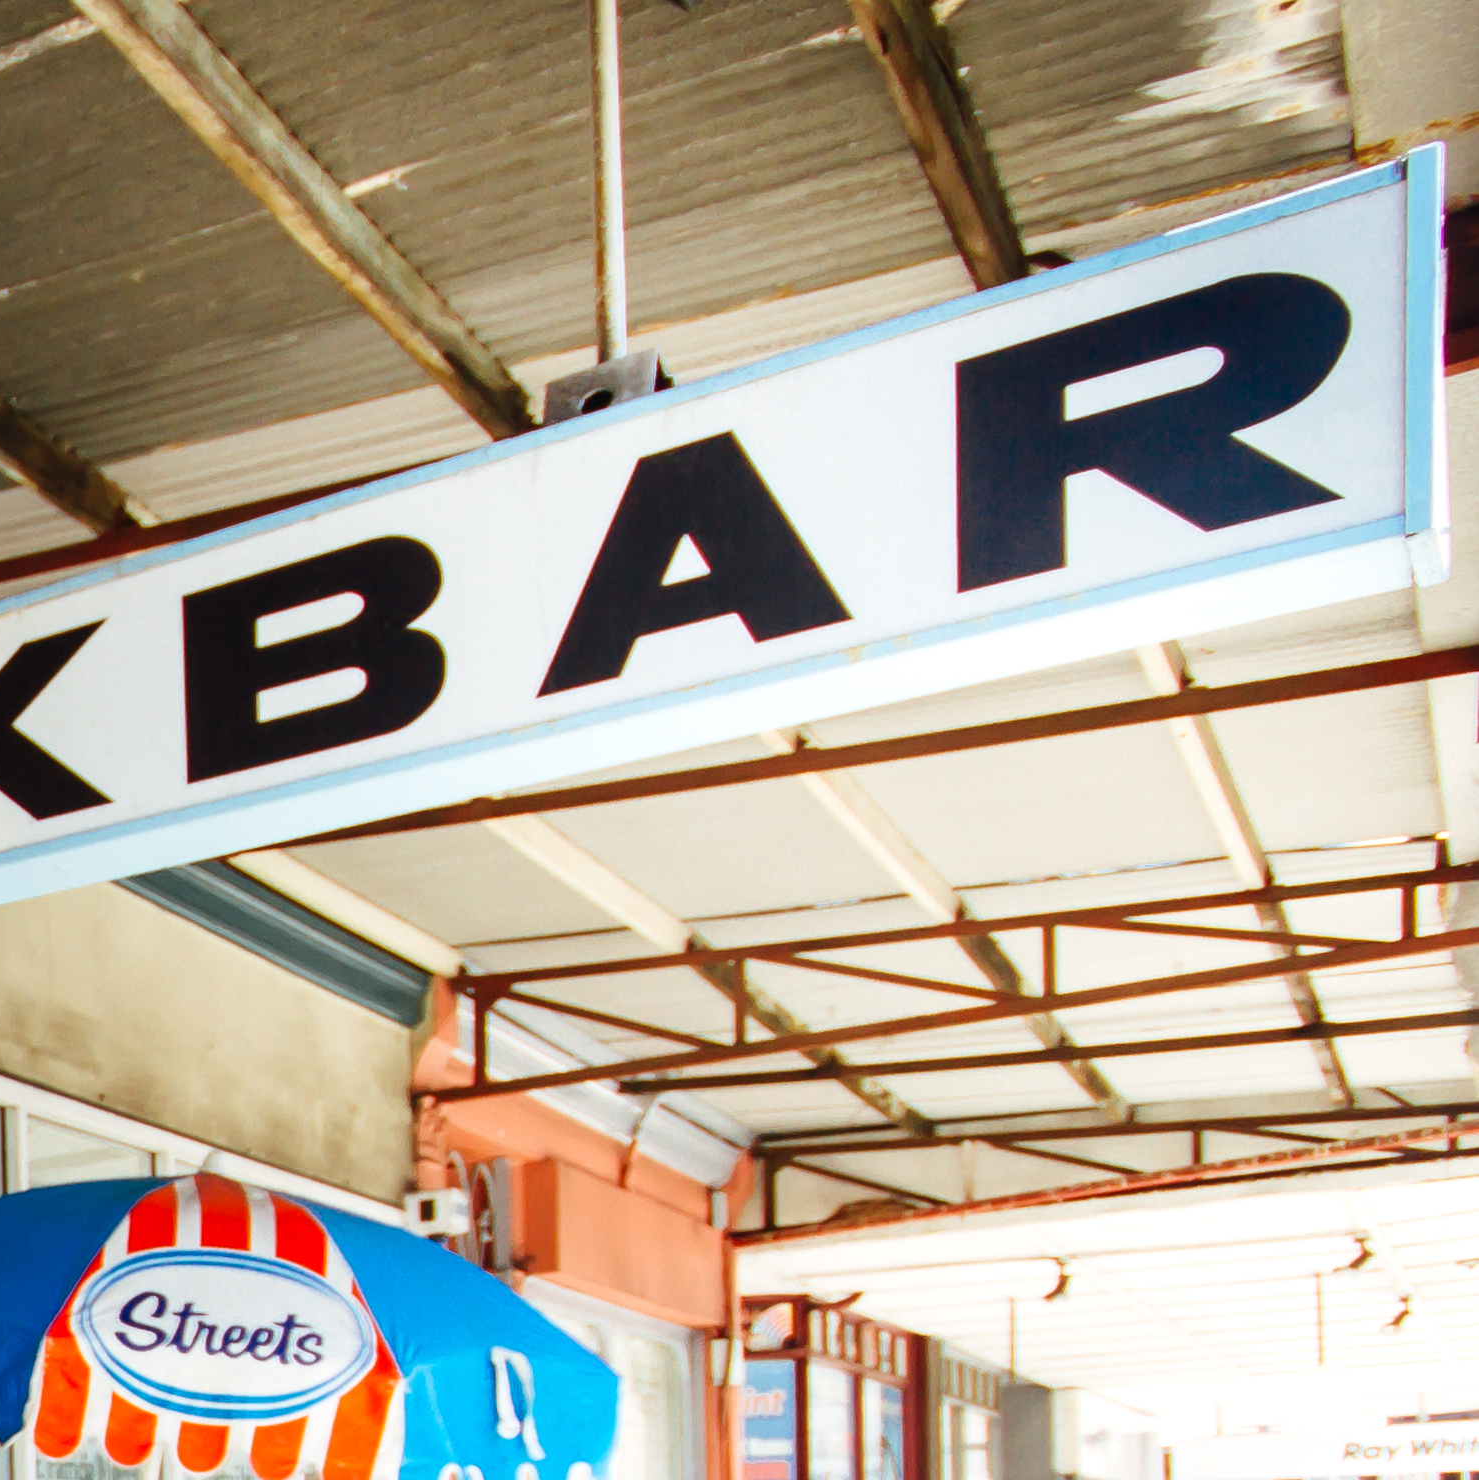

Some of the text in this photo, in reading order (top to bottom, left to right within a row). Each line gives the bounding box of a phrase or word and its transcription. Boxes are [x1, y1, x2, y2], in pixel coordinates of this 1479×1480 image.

[113, 1290, 325, 1367] Streets
[1343, 1438, 1479, 1461] Ray Whit
